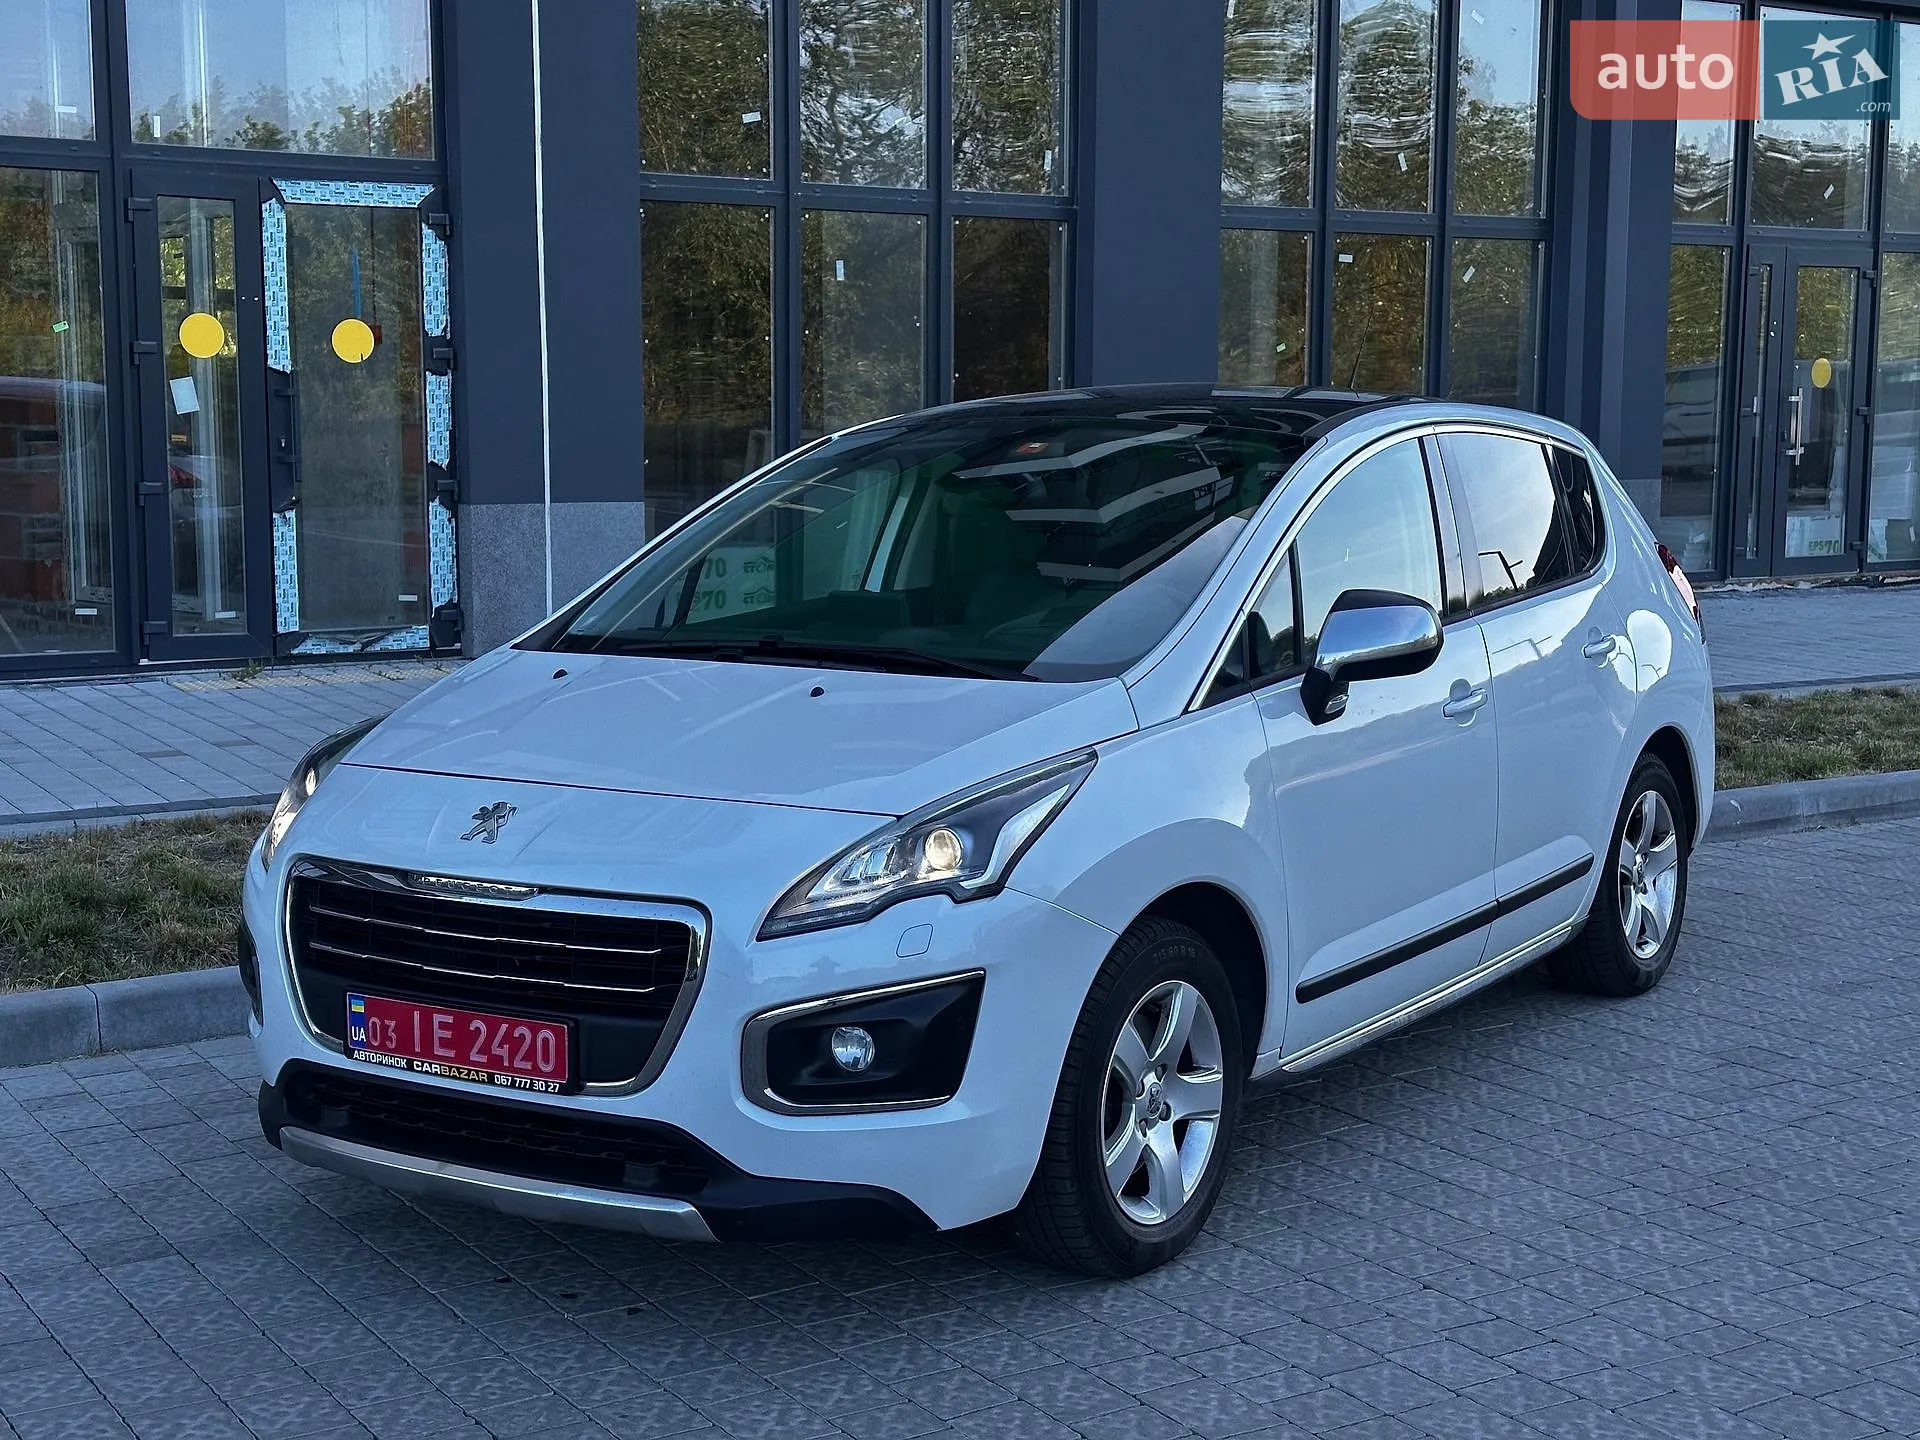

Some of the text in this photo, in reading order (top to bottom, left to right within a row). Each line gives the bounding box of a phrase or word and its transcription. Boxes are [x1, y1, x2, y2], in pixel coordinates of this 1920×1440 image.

[351, 1026, 367, 1043] UA
[368, 1010, 556, 1073] 03 IE 2420
[353, 1050, 408, 1069] АВТОРИНОК
[413, 1060, 488, 1082] CARBAZAR
[494, 1074, 512, 1086] 067
[514, 1076, 530, 1090] 777
[547, 1082, 560, 1093] 27
